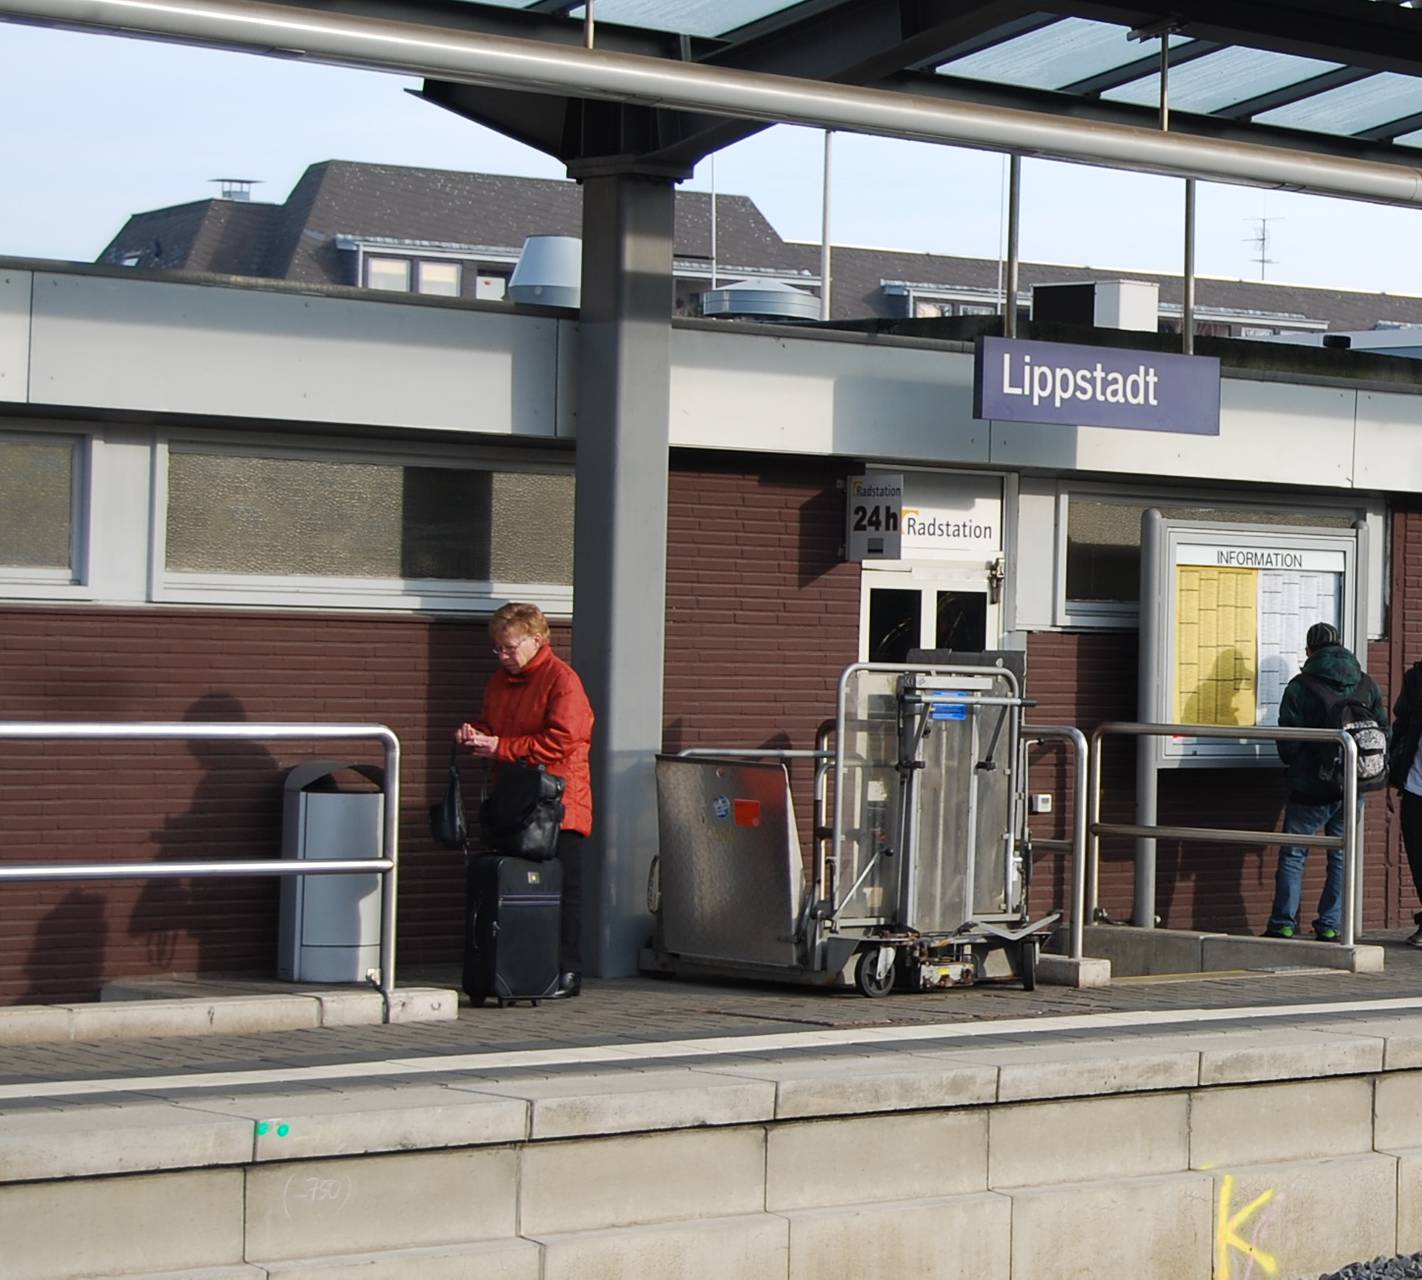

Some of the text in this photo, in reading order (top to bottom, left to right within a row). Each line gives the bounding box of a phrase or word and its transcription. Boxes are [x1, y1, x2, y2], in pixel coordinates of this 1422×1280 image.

[1002, 353, 1159, 408] Lippstadt
[855, 484, 901, 497] Radstation
[907, 517, 992, 539] Radstation
[1216, 550, 1303, 568] INFORMATION
